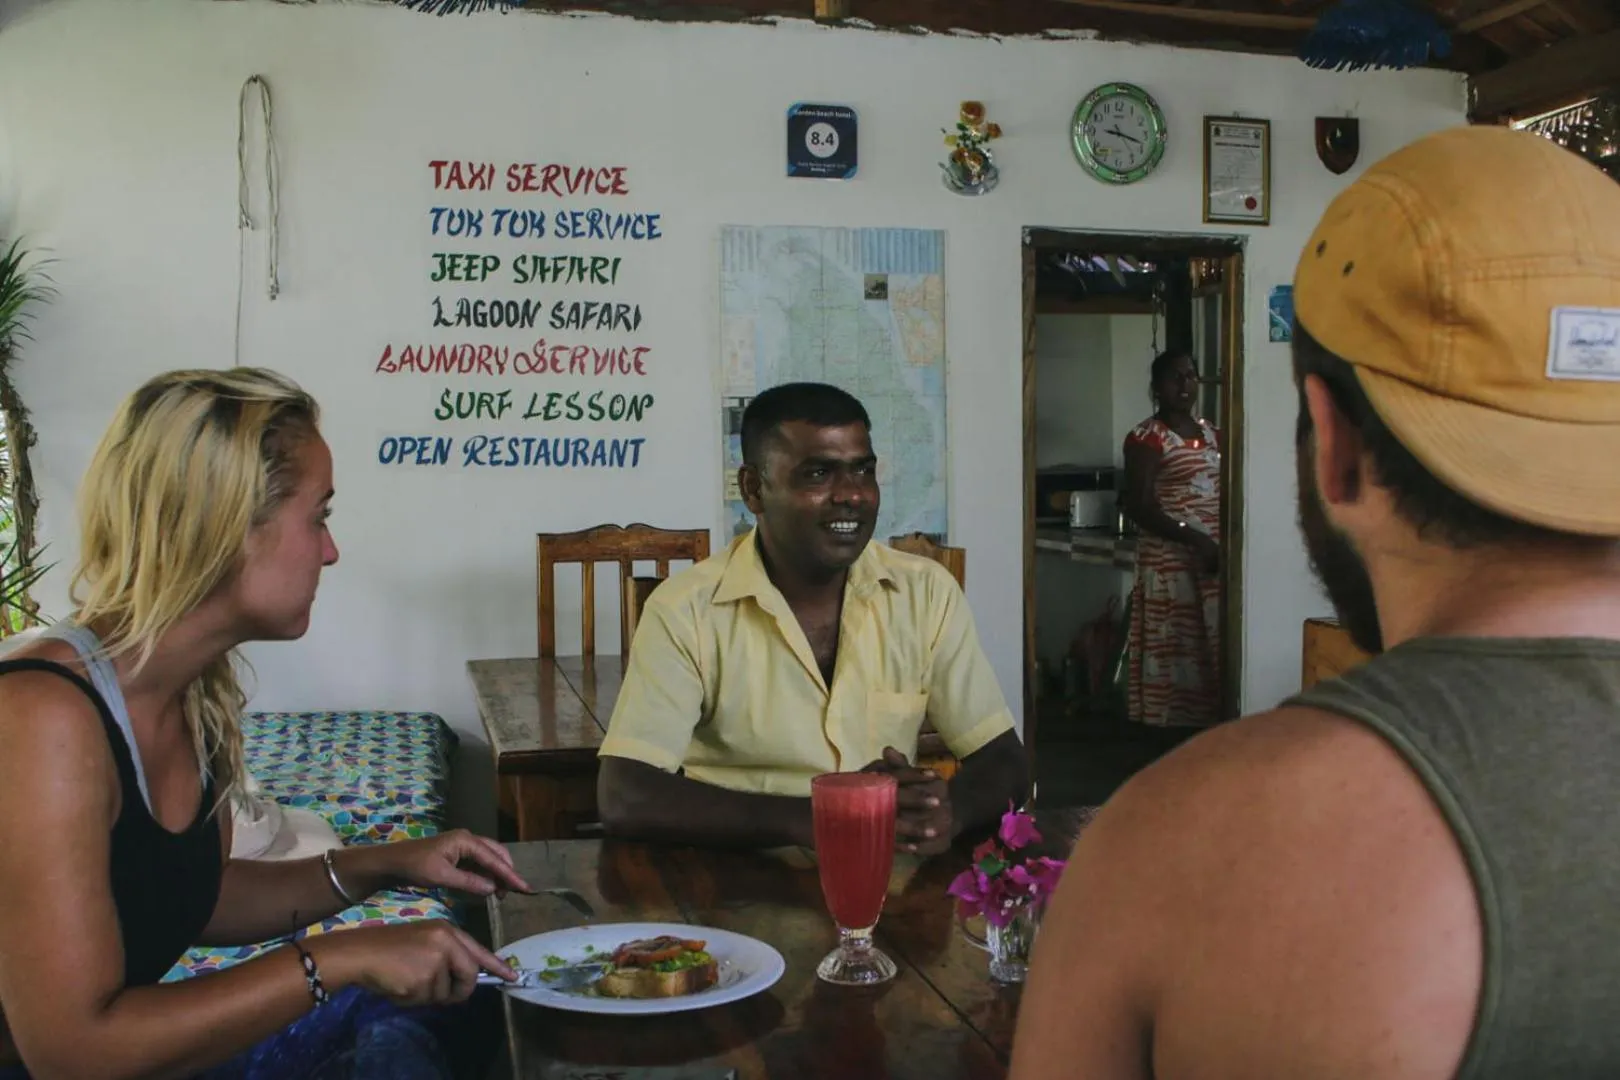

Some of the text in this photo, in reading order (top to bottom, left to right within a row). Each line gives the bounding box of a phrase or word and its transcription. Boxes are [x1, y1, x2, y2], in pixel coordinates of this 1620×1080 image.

[811, 131, 835, 146] 8.4
[428, 160, 628, 197] TAXI SERVICE
[430, 207, 662, 240] TUK TUK SERVICE
[431, 253, 621, 285] JEEP SAFARI
[432, 296, 641, 332] LAGOON SAFARI
[376, 338, 651, 376] LAUNDRY SERVICE
[434, 388, 654, 422] SURF LESSON
[379, 435, 646, 467] OPEN RESTAURANT
